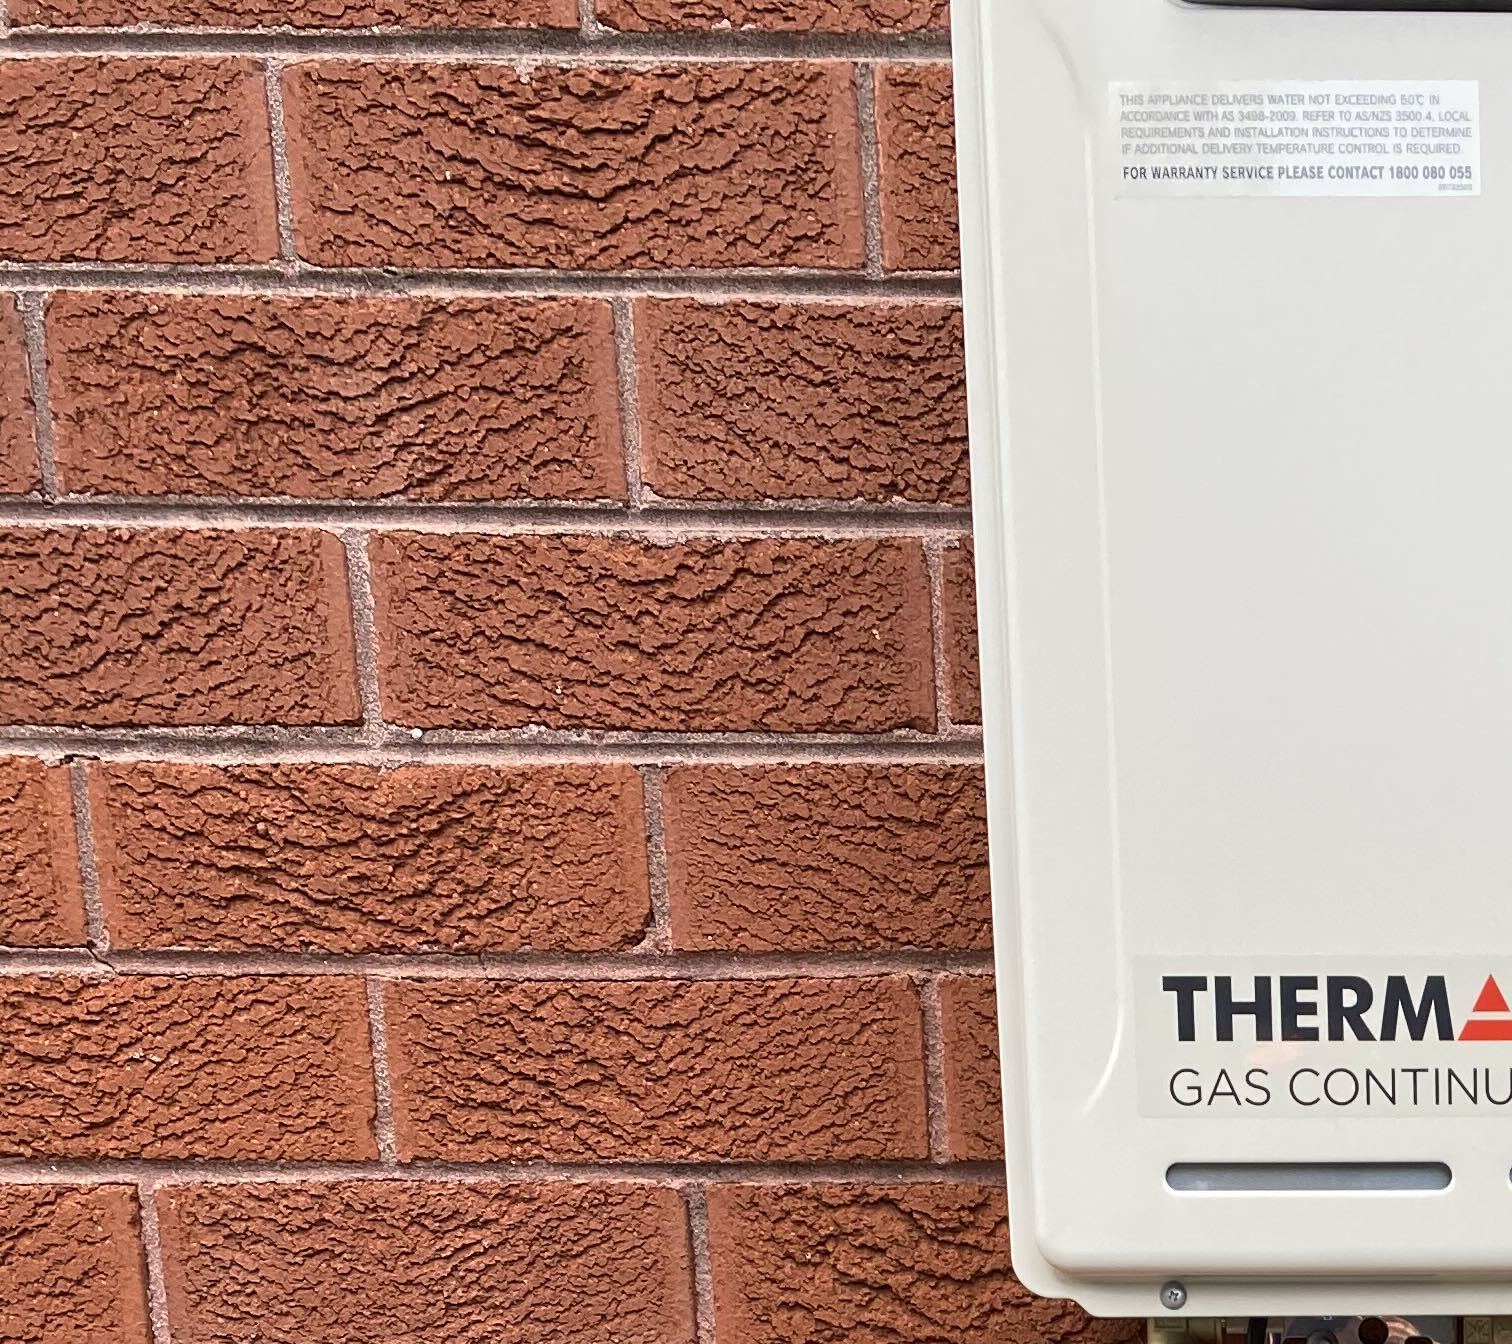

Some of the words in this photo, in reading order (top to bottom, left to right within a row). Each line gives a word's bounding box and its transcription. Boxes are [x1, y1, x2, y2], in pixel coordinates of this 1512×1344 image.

[1120, 94, 1144, 106] THIS
[1147, 94, 1208, 106] APPLIANCE
[1211, 94, 1264, 106] DELIVERS
[1267, 94, 1305, 106] WATER
[1308, 94, 1331, 106] NOT
[1335, 94, 1397, 106] EXCEEDING
[1429, 94, 1440, 106] IN
[1120, 110, 1190, 122] ACCORDANCE
[1193, 110, 1218, 122] WITH
[1221, 110, 1234, 122] AS
[1302, 110, 1335, 122] REFER
[1339, 110, 1351, 122] TO
[1355, 110, 1392, 122] AS/NZS
[1438, 110, 1472, 122] LOCAL
[1121, 127, 1205, 138] REQUIREMENTS
[1208, 127, 1231, 138] AND
[1234, 127, 1309, 138] INSTALLATION
[1312, 127, 1390, 138] INSTRUCTIONS
[1394, 127, 1407, 138] TO
[1411, 127, 1472, 138] DETERMINE
[1121, 143, 1131, 154] IF
[1134, 143, 1199, 154] ADDITIONAL
[1202, 143, 1252, 154] DELIVERY
[1256, 143, 1335, 154] TEMPERATURE
[1338, 143, 1389, 154] CONTROL
[1393, 143, 1403, 154] IS
[1123, 166, 1147, 179] FOR
[1151, 166, 1218, 179] WARRANTY
[1222, 166, 1274, 179] SERVICE
[1278, 166, 1324, 179] PLEASE
[1328, 166, 1384, 179] CONTACT
[1389, 166, 1418, 179] 1800
[1423, 166, 1445, 179] 080
[1449, 166, 1472, 179] 055
[1168, 1067, 1271, 1107] GAS
